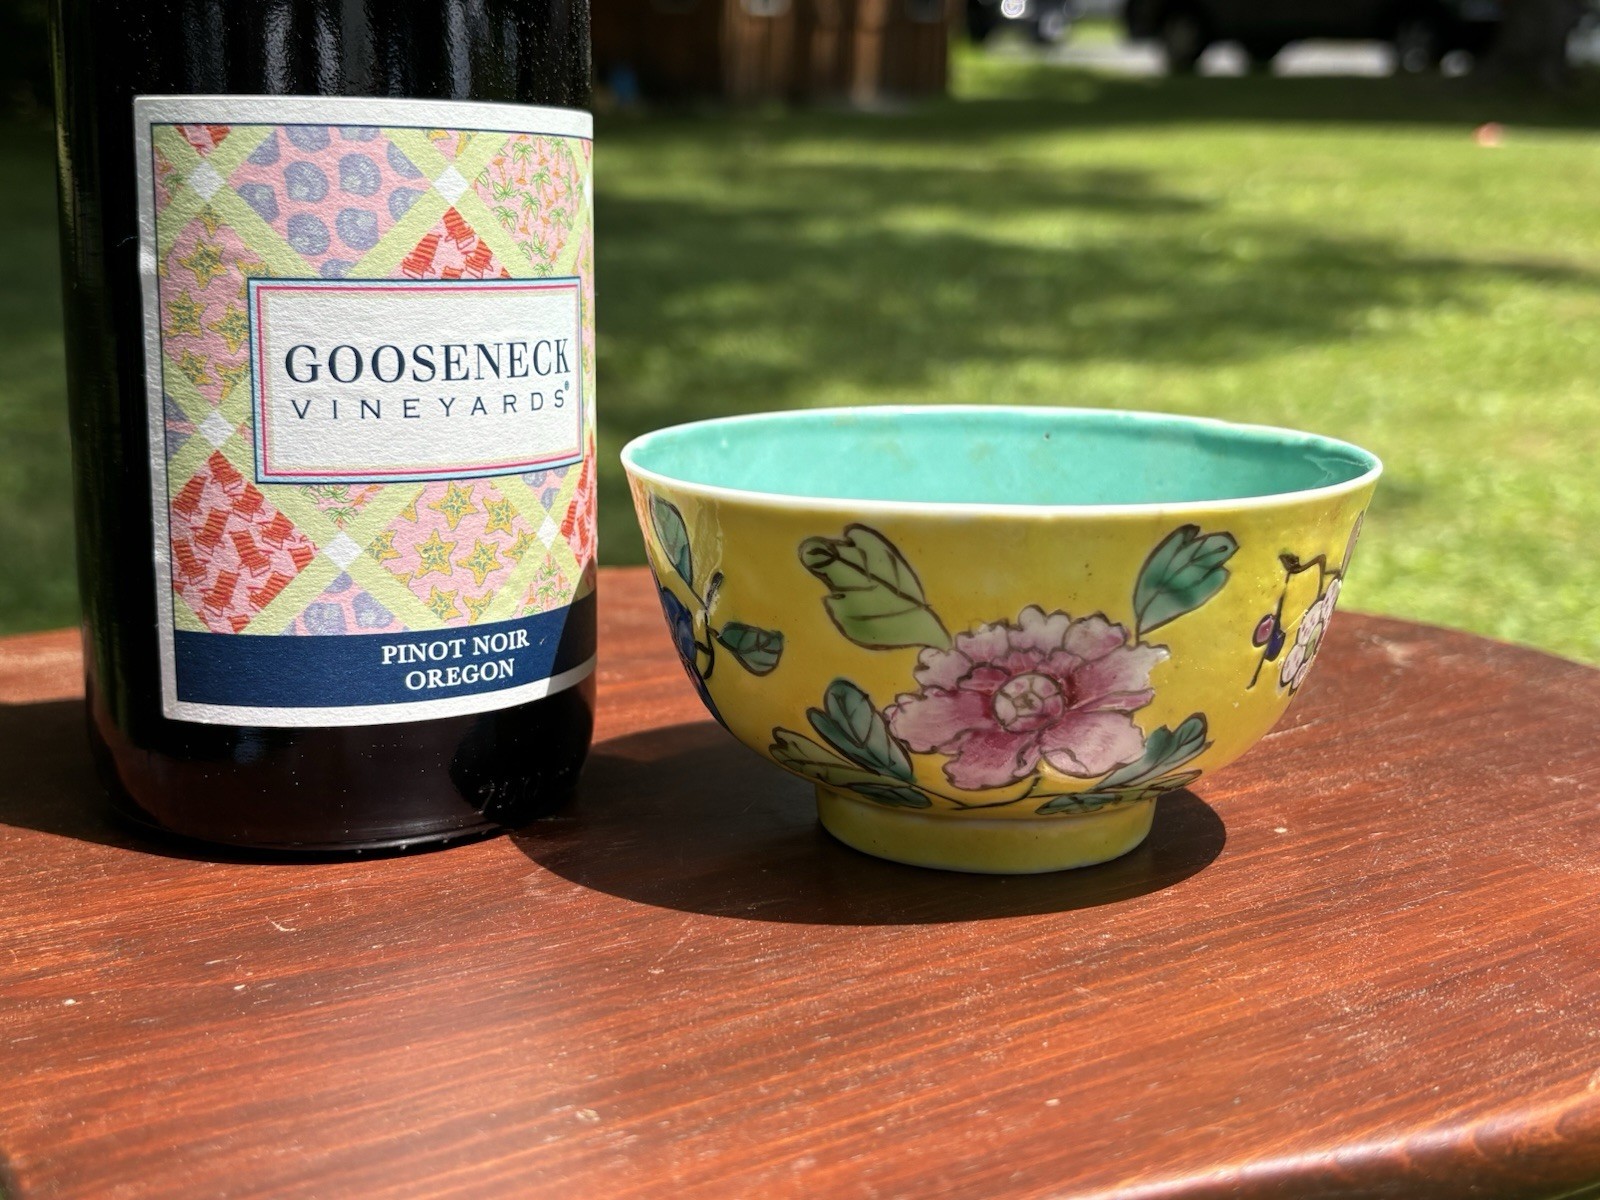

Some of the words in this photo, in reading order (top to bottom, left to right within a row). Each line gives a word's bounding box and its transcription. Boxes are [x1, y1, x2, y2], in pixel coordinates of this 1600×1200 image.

[285, 338, 571, 383] GOOSENECK
[381, 639, 466, 665] PINOT
[472, 629, 530, 655] NOIR
[405, 658, 515, 690] OREGON
